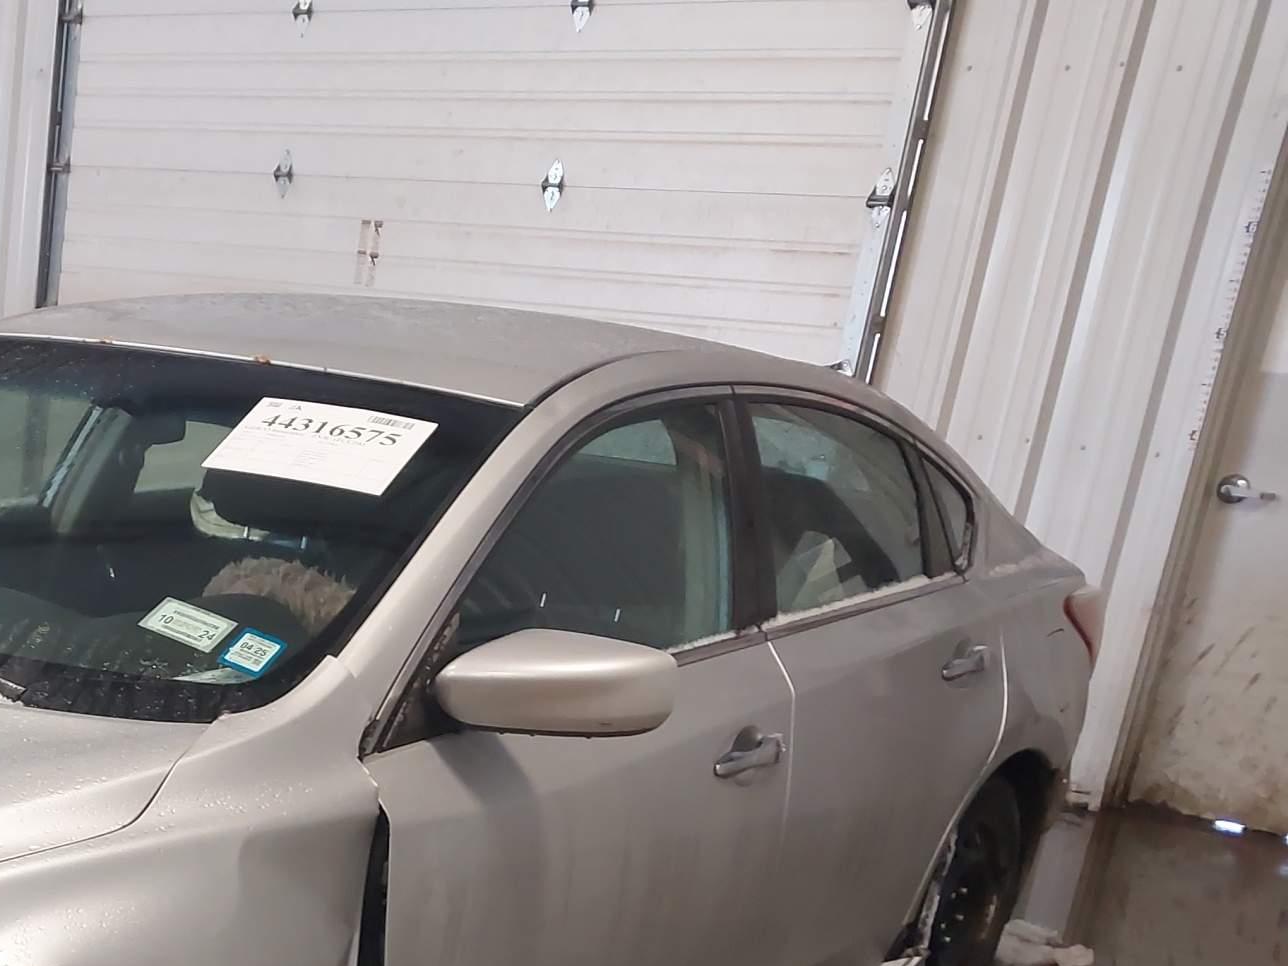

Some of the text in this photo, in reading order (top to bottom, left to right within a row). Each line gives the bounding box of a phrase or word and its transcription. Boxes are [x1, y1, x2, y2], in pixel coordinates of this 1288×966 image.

[262, 414, 402, 446] 44316575
[158, 614, 174, 625] 10
[198, 630, 216, 640] 24
